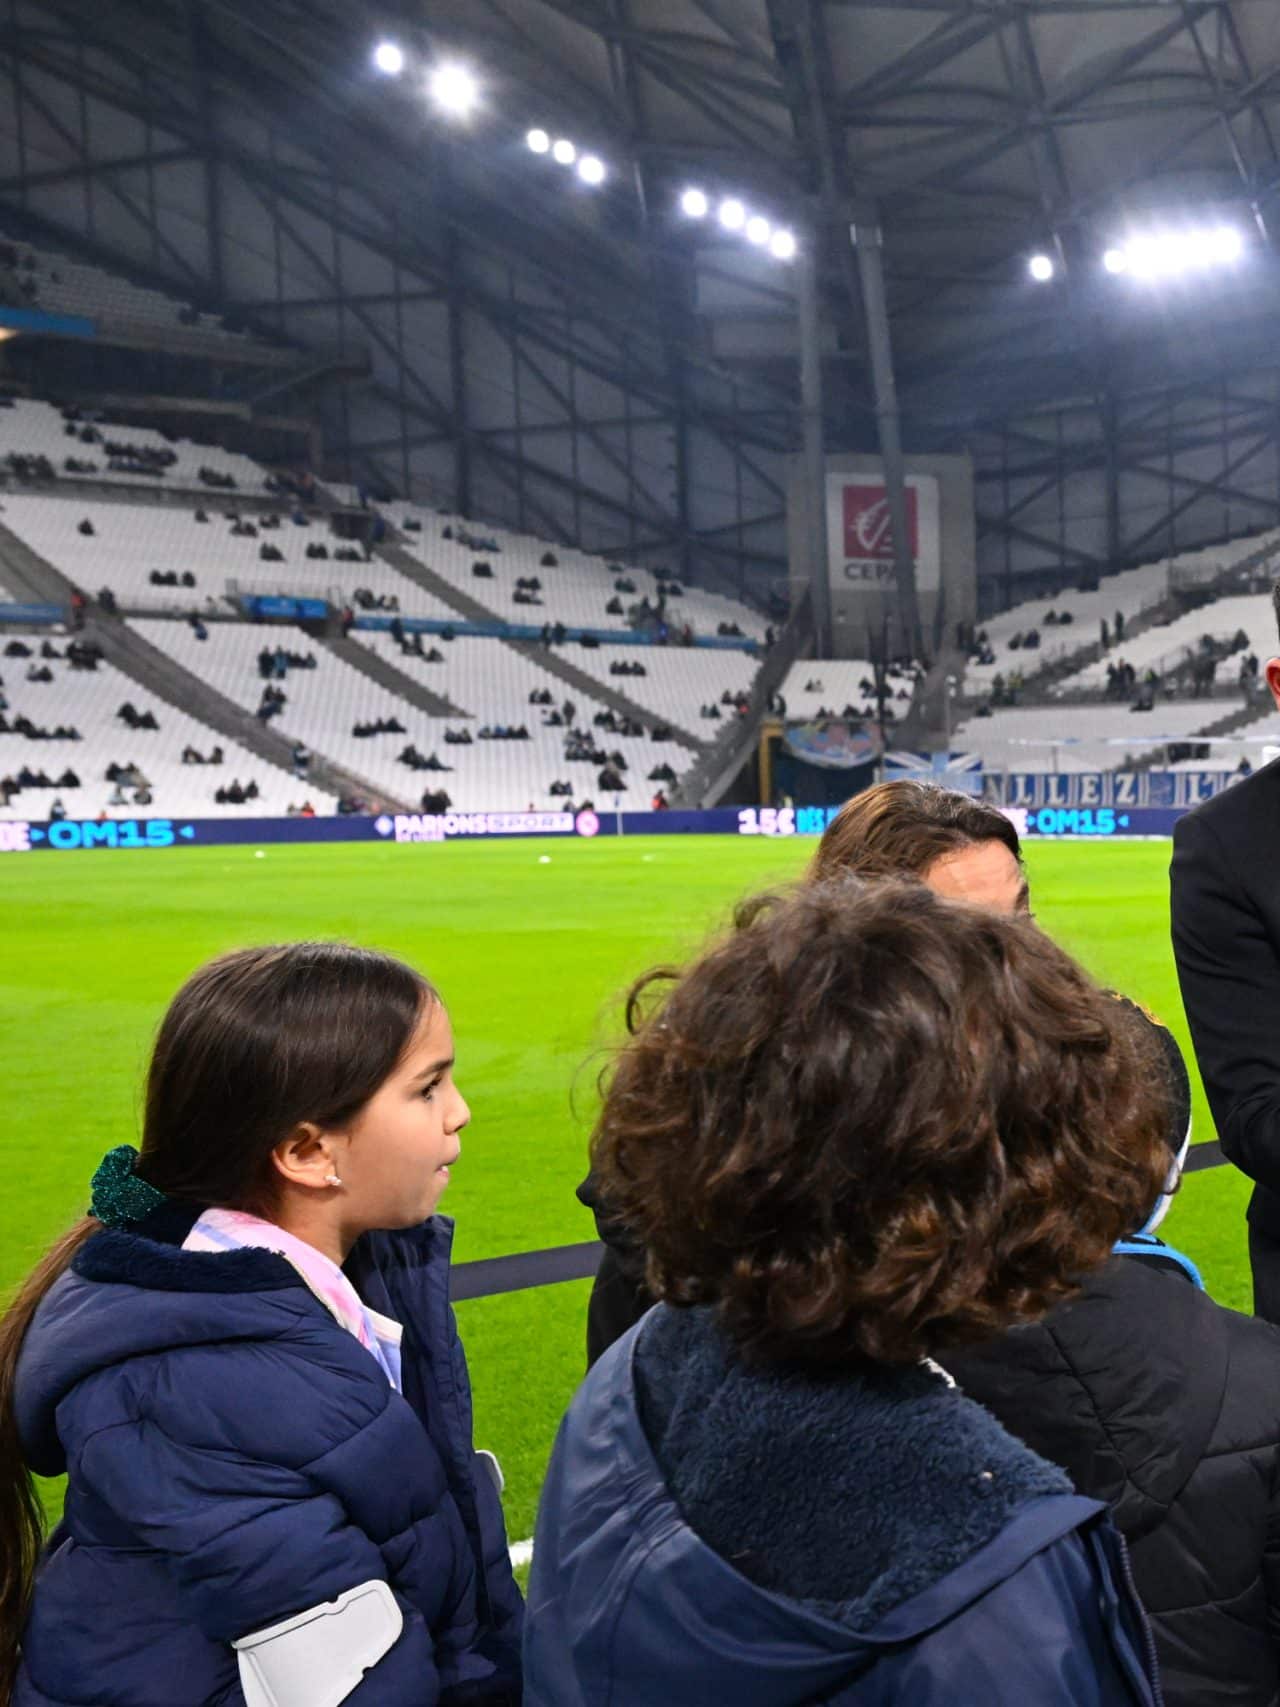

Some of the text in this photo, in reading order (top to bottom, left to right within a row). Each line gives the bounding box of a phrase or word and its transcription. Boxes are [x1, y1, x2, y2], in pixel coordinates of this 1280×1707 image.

[844, 563, 898, 580] CEP
[49, 820, 175, 848] OM15
[1037, 808, 1116, 834] OM15
